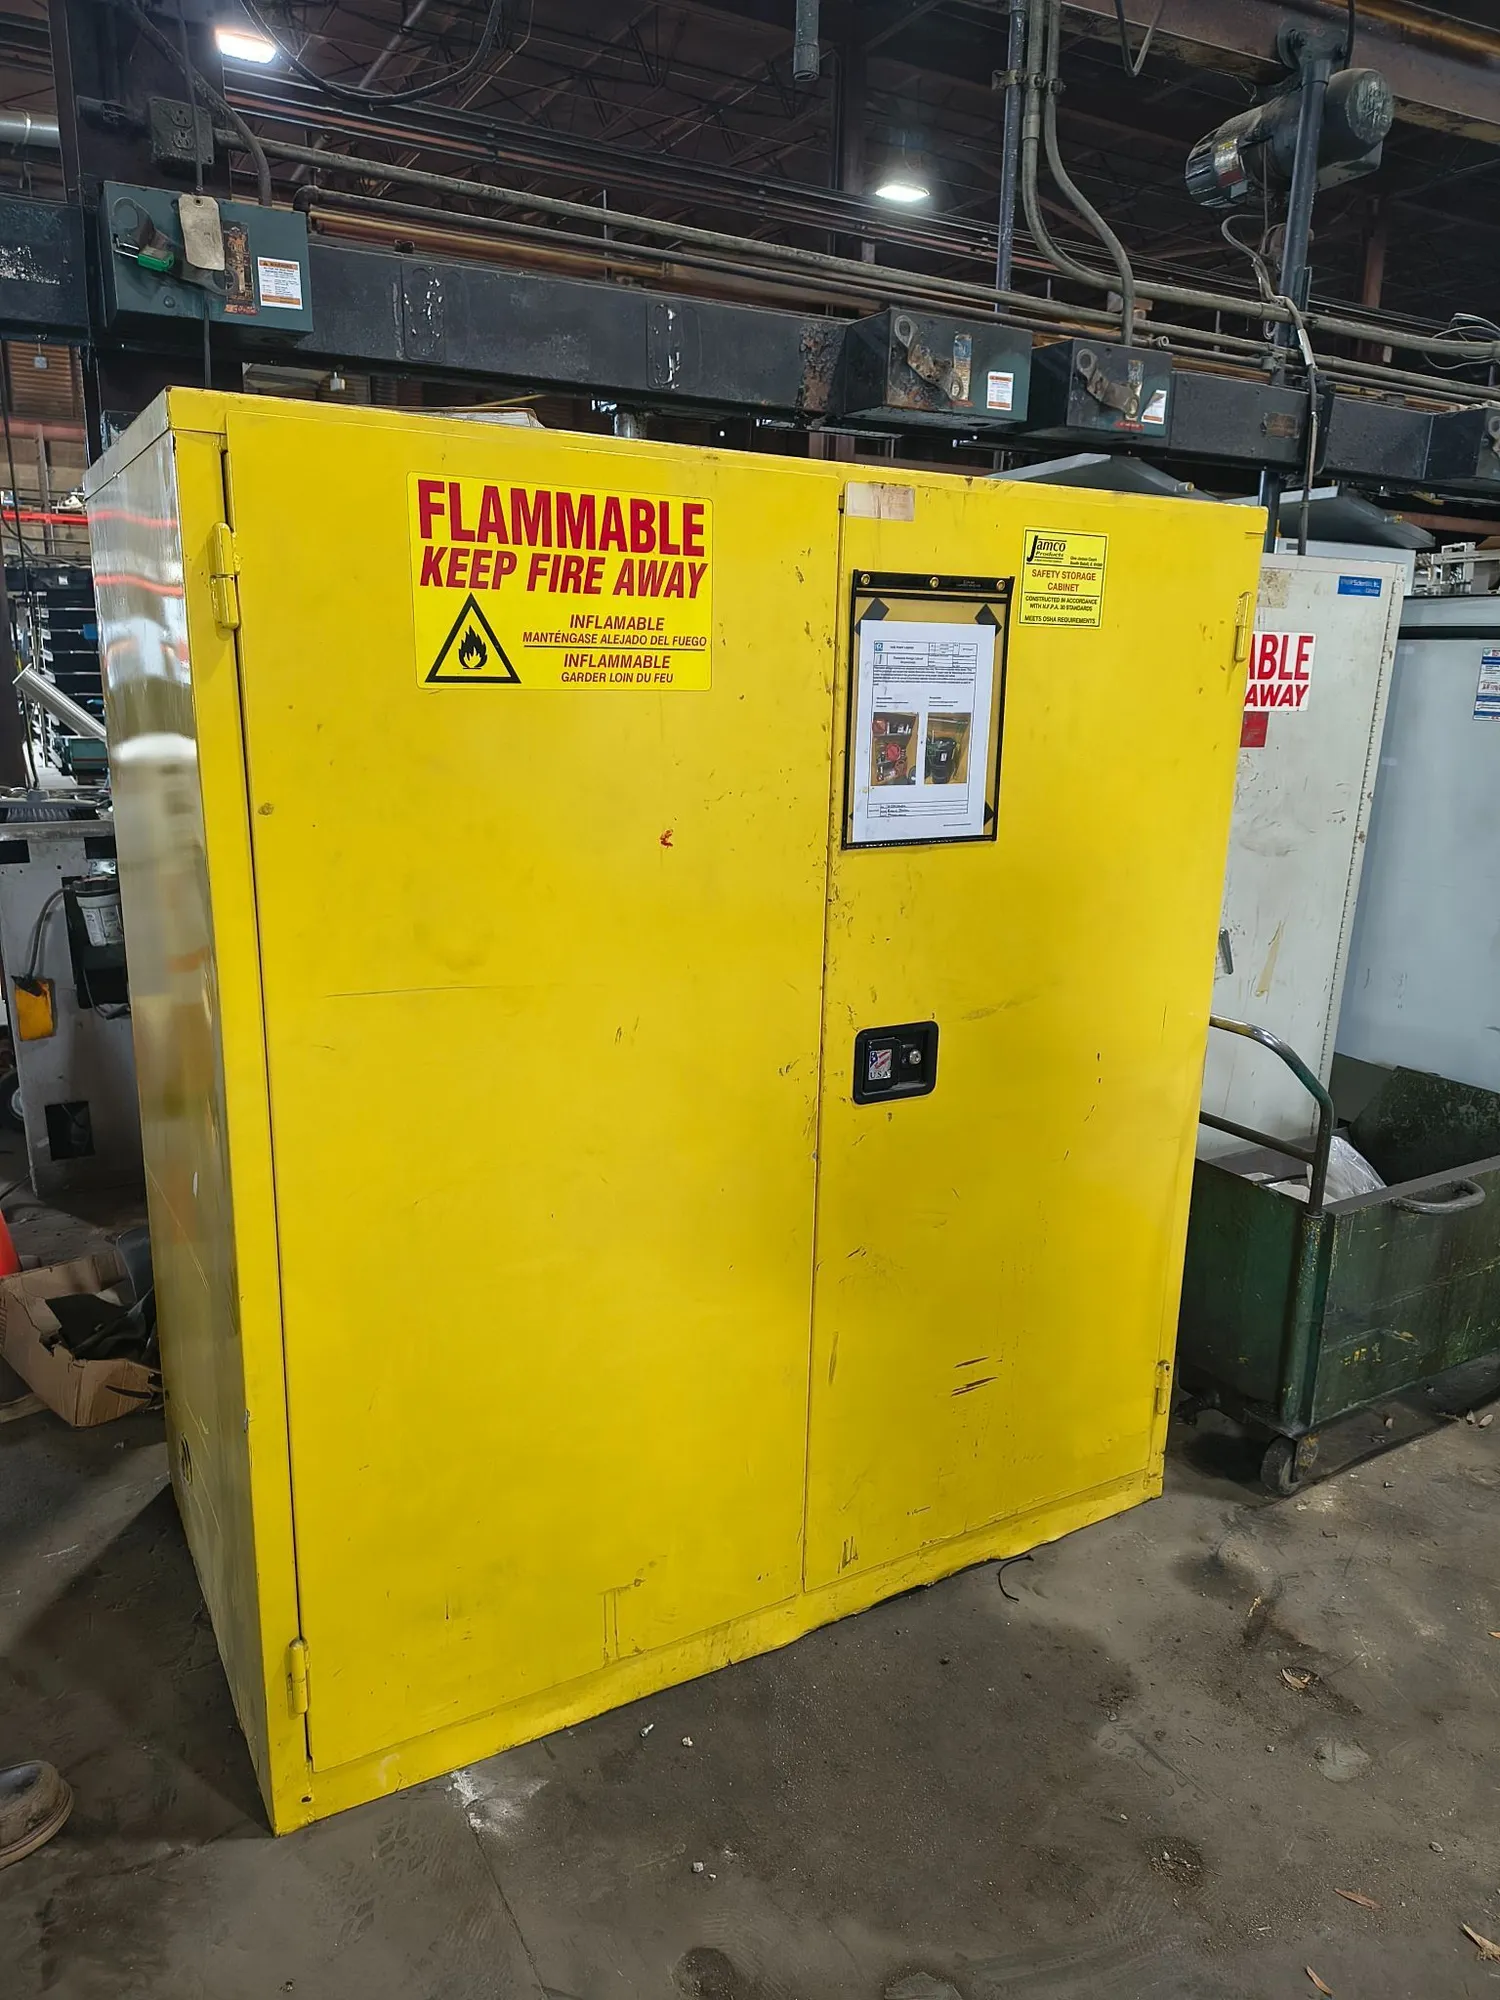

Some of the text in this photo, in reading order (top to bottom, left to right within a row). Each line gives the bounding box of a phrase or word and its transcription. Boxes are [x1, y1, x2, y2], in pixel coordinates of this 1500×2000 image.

[418, 479, 705, 557] FLAMMABLE
[1026, 535, 1066, 562] Jamco
[420, 546, 708, 598] KEEP FIRE AWAY
[1032, 569, 1096, 581] SAFETY STORAGE
[1047, 582, 1080, 592] CABINET
[1025, 595, 1060, 603] CONSTRUCTED
[570, 614, 665, 631] INFLAMABLE
[1057, 616, 1096, 624] REQUIREMENTS
[522, 630, 707, 647] MANTÉNGASE ALEJADO DEL FUEGO
[564, 653, 671, 669] INFLAMMABLE
[561, 672, 673, 683] GARDER LOIN DU FEU
[1244, 684, 1309, 707] AWAY
